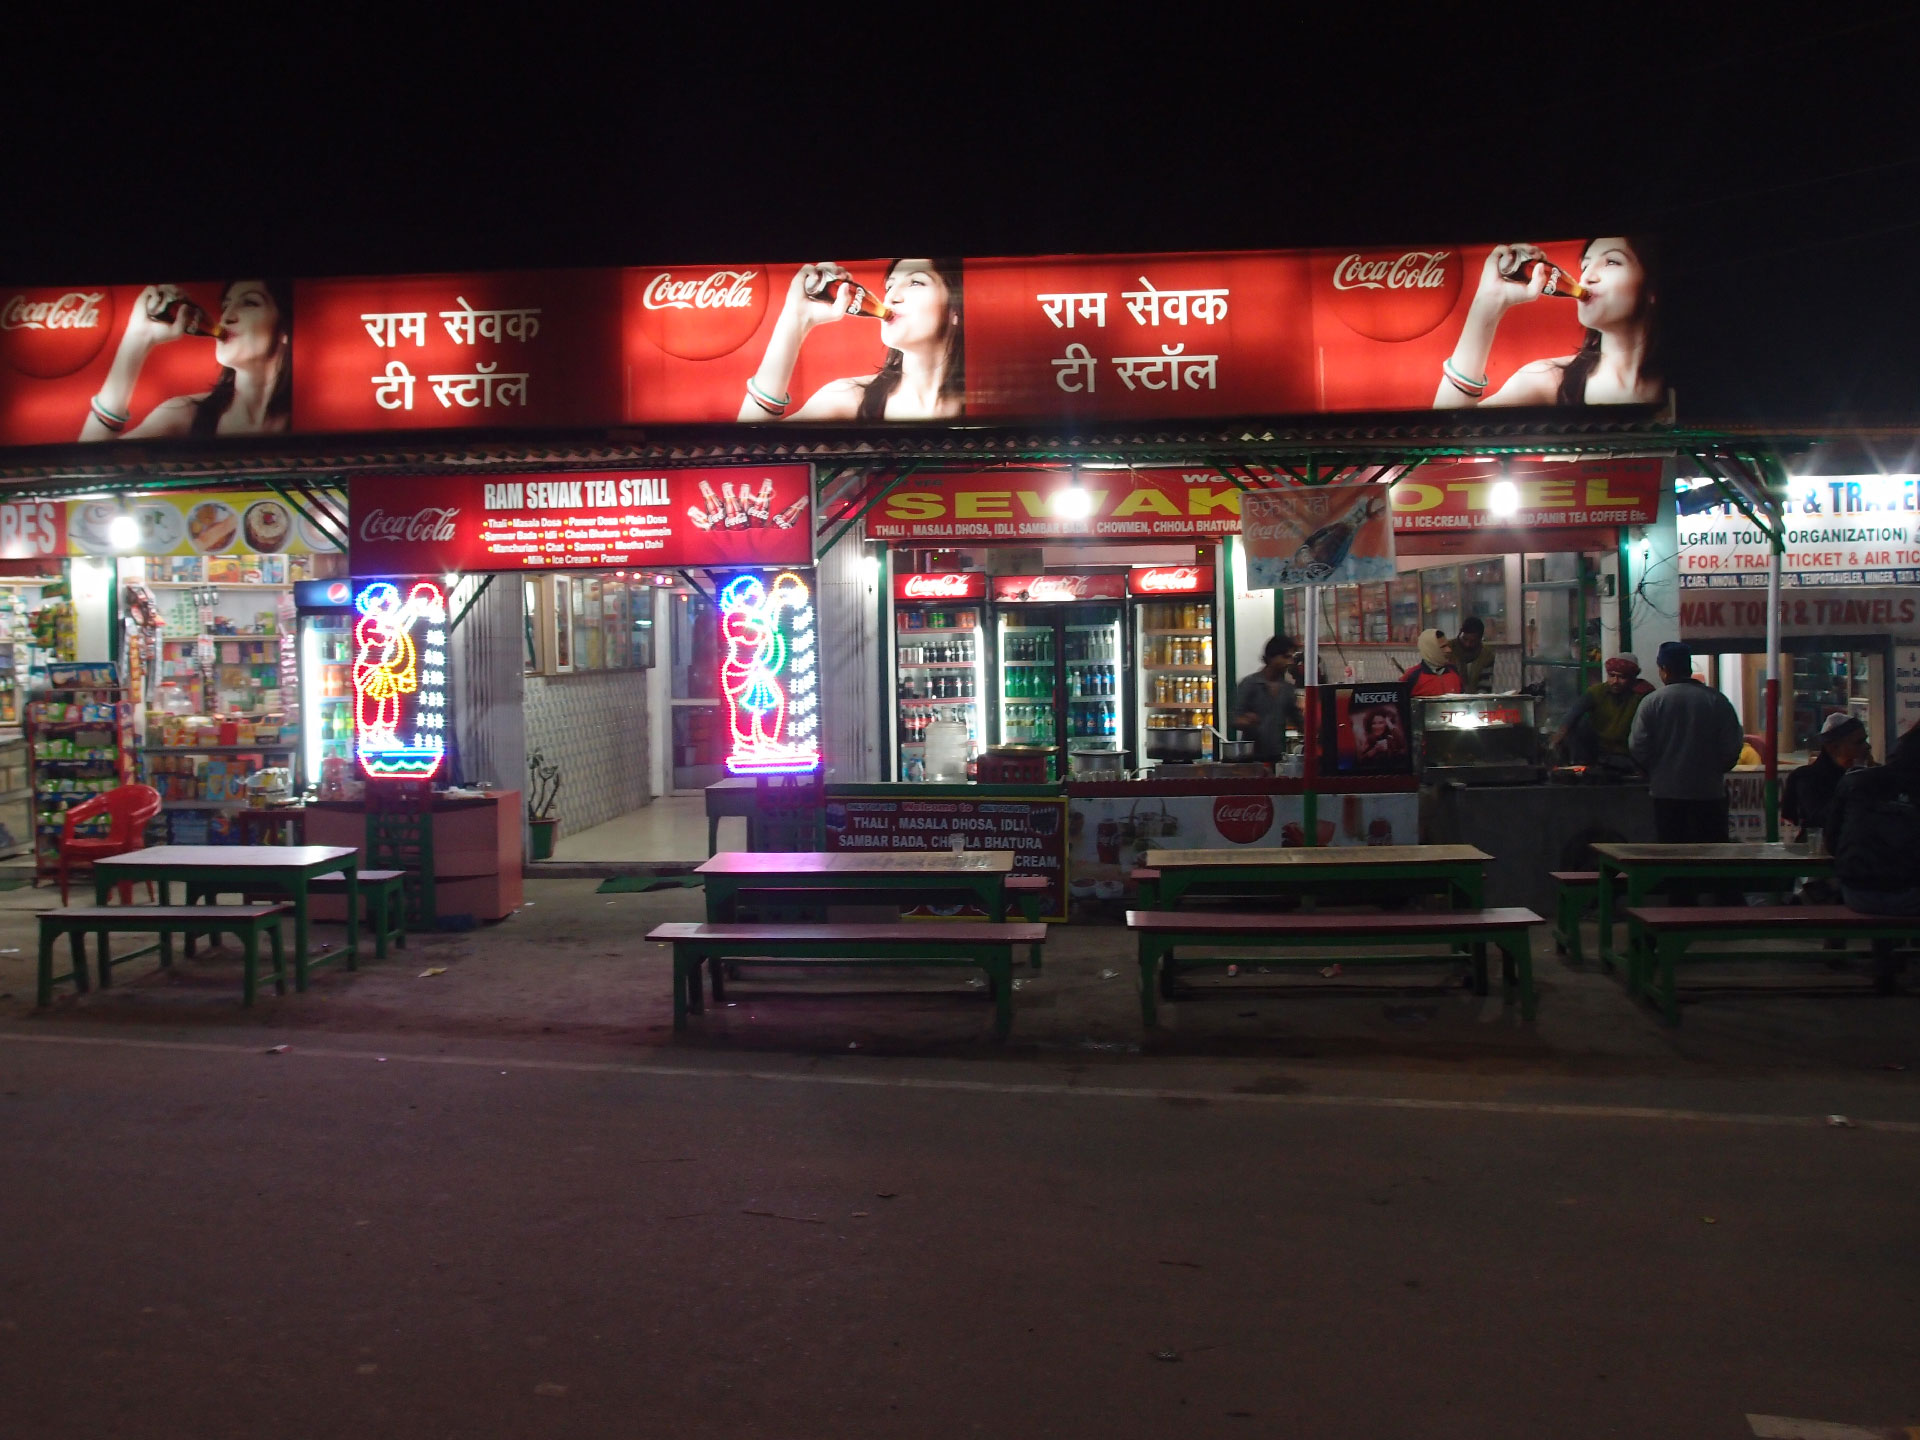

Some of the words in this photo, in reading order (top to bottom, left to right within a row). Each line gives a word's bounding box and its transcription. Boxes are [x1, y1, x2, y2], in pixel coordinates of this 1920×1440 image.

[1333, 252, 1450, 290] Coca-Cola
[643, 270, 759, 310] Coca-Cola
[1037, 293, 1107, 328] राम
[1121, 276, 1229, 326] सेवक
[0, 293, 104, 329] Coca-Cola
[361, 312, 427, 348] राम
[439, 296, 541, 345] सेवक
[1051, 343, 1097, 393] टी
[1112, 343, 1218, 391] स्टॉल
[371, 361, 416, 411] टी
[428, 362, 529, 408] स्टॉल
[484, 483, 524, 509] RAM
[526, 481, 583, 509] SEVAK
[585, 480, 617, 507] TEA
[619, 478, 670, 507] STALL
[1828, 480, 1920, 513] TRE
[0, 503, 56, 553] RES
[360, 507, 460, 541] Coca-Cola
[875, 525, 905, 536] THALI
[913, 524, 952, 536] MASALA
[955, 523, 992, 537] DHOSA,
[994, 523, 1017, 537] IDLI,
[1097, 520, 1151, 534] CHOWMEN,
[1154, 520, 1194, 533] CHHOLA
[1196, 519, 1243, 532] BHATURA
[1246, 518, 1304, 542] Coca-C
[1415, 514, 1471, 528] ICE-CREAM,
[1568, 511, 1588, 523] TEA
[1590, 510, 1627, 522] COFFEE
[1788, 528, 1907, 544] ORGANIZATION)
[1688, 554, 1719, 569] FOR
[1734, 553, 1772, 568] TRAI
[1786, 552, 1843, 567] TICKET
[1848, 551, 1859, 566] &
[1864, 550, 1891, 565] AIR
[1815, 598, 1915, 625] TRAVELS
[1355, 692, 1397, 704] NESCAFÉ
[853, 816, 888, 829] THALI
[899, 817, 948, 830] MASALA
[952, 818, 997, 833] DHOSA,
[1001, 818, 1028, 834] IDLI,
[1217, 804, 1269, 822] Coca-Cola
[838, 835, 888, 847] SAMBAR
[893, 835, 928, 849] BADA,
[931, 835, 981, 848] CHLA
[984, 836, 1043, 849] BHATURA
[1014, 855, 1060, 869] CREAM,
